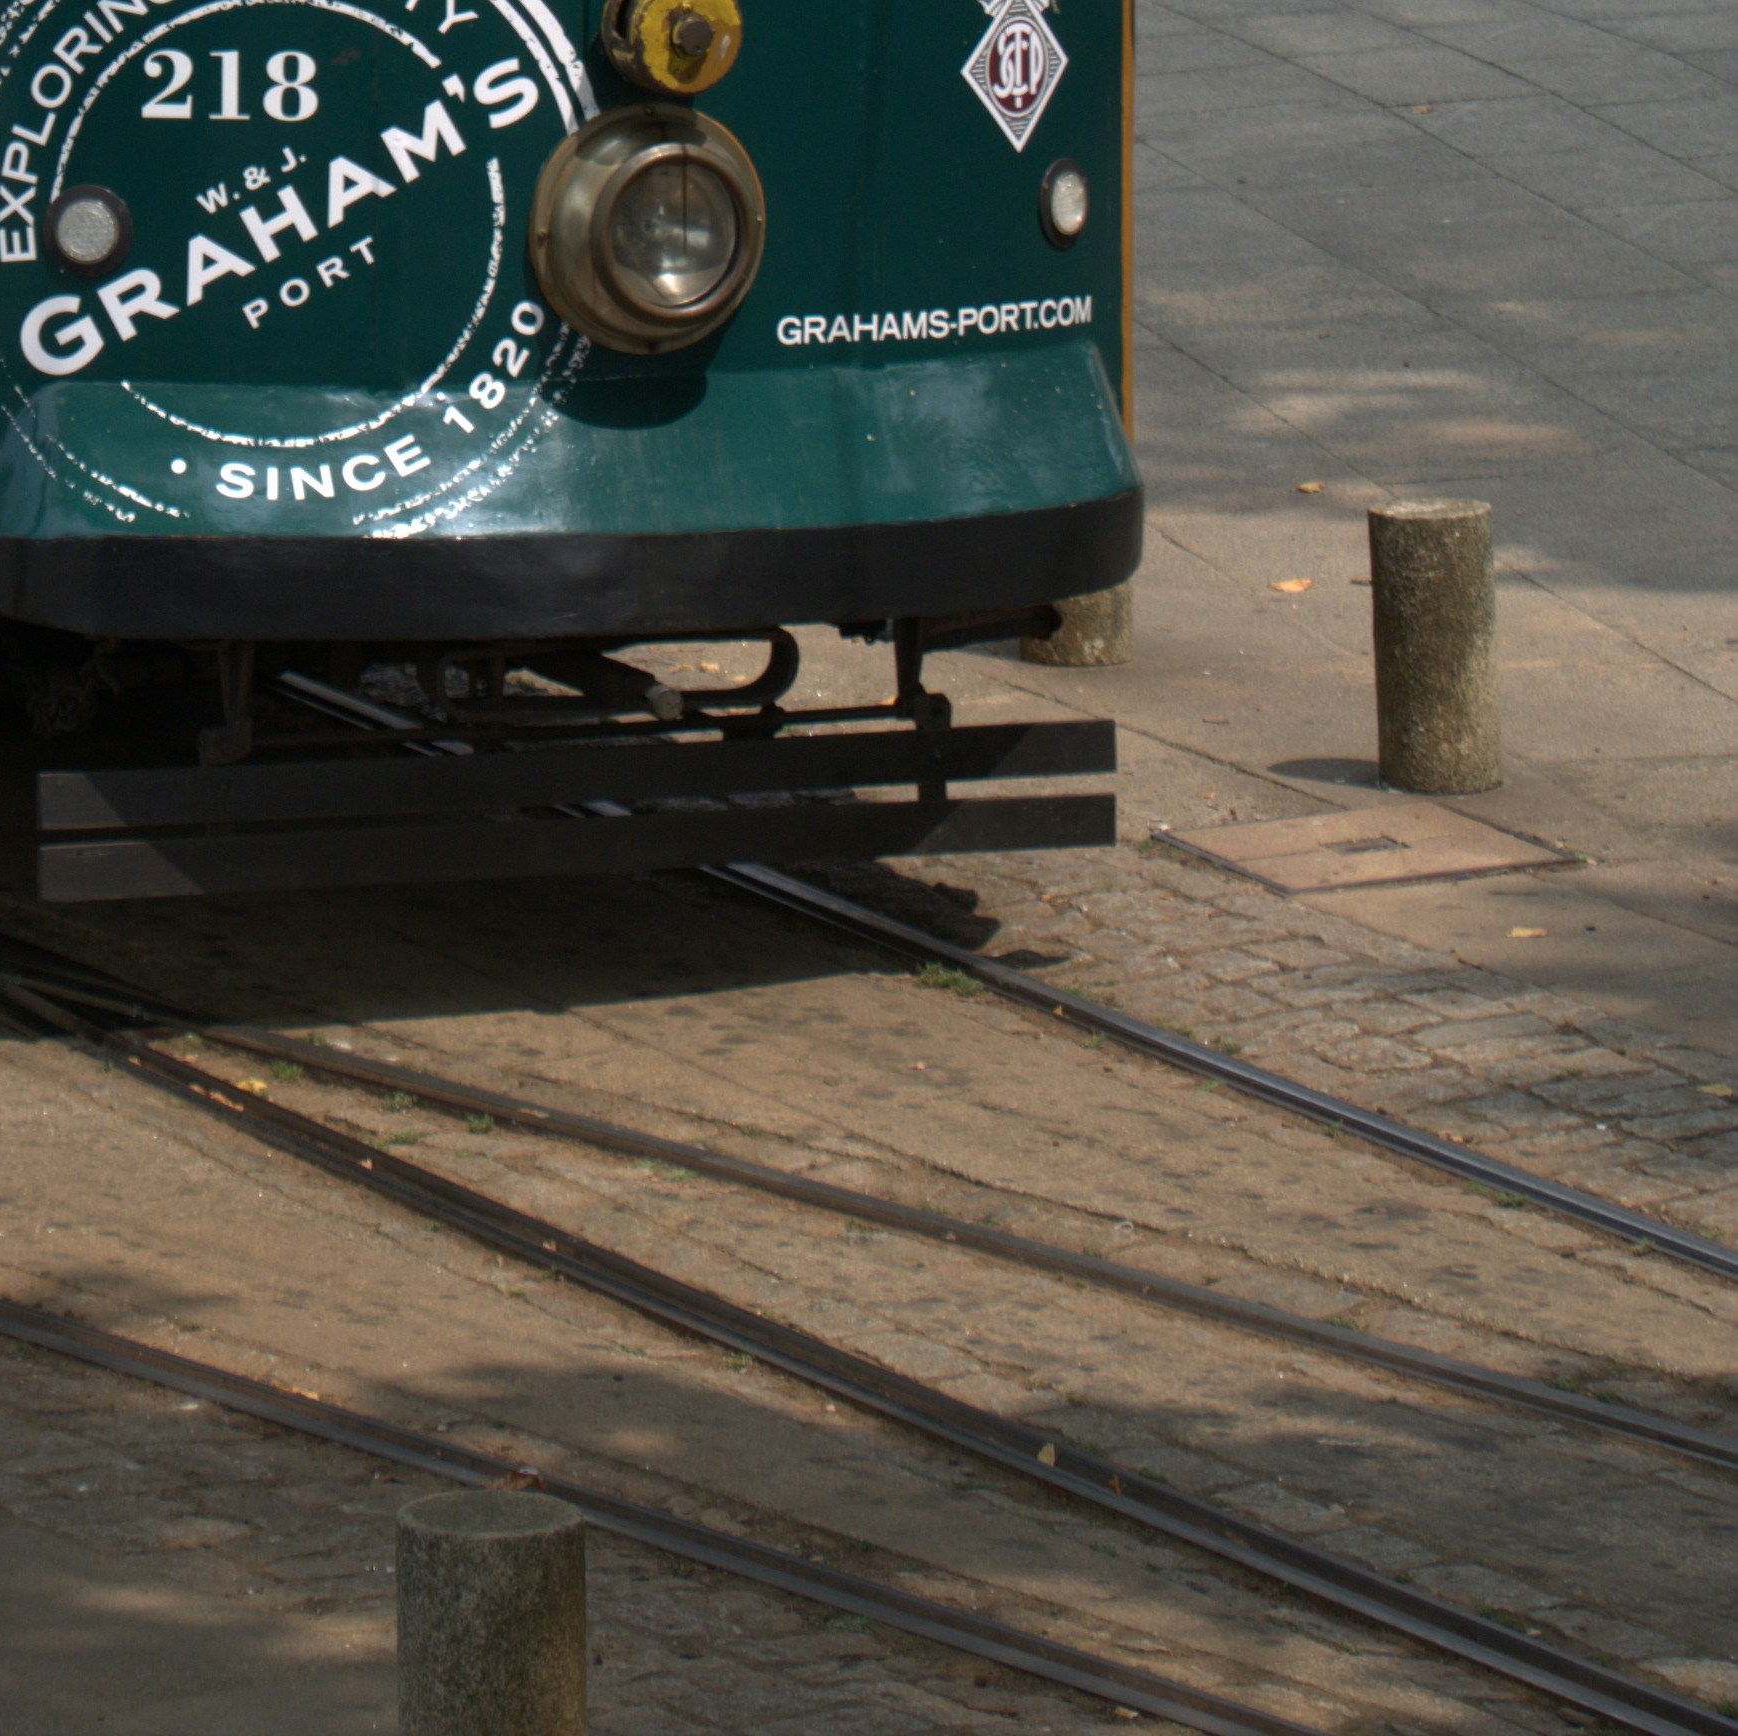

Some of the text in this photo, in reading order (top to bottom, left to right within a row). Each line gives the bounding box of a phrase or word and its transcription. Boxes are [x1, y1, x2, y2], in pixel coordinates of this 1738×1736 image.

[140, 49, 320, 123] 218
[19, 57, 540, 377] GRAHAM'S
[195, 146, 308, 215] W. & J.
[241, 236, 379, 330] PORT
[776, 294, 1093, 346] GRAHAMS-PORT.COM
[215, 300, 545, 502] SINCE 1820
